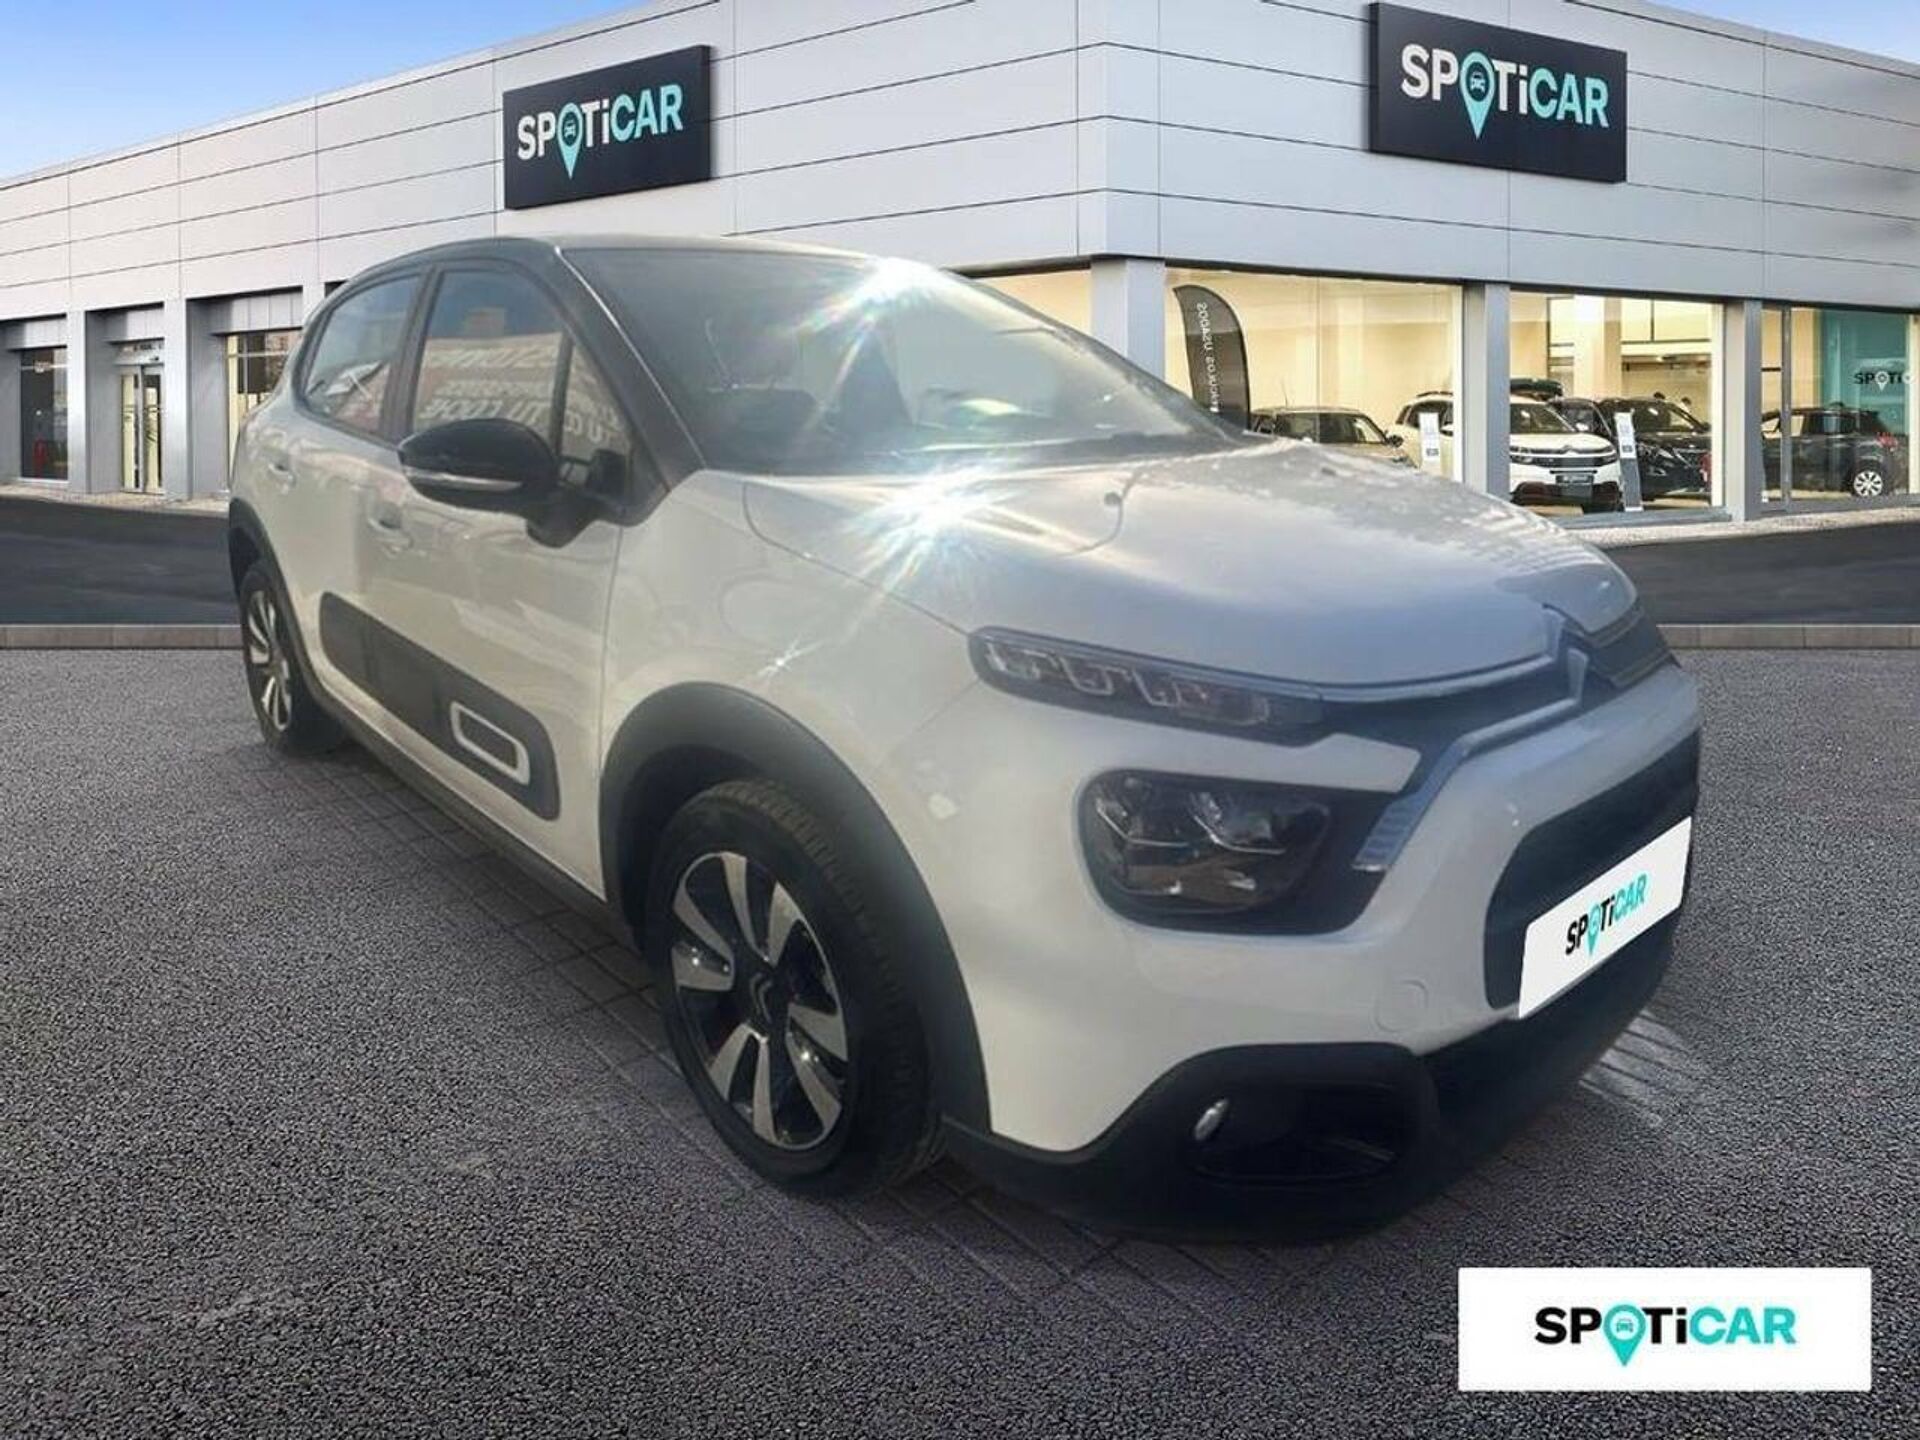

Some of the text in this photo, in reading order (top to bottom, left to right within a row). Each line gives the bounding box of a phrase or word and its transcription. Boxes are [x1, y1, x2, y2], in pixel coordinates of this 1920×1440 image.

[517, 83, 684, 180] SPOTiCAR
[1401, 43, 1610, 140] SPOTiCAR
[1565, 873, 1648, 956] SPOTiCAR
